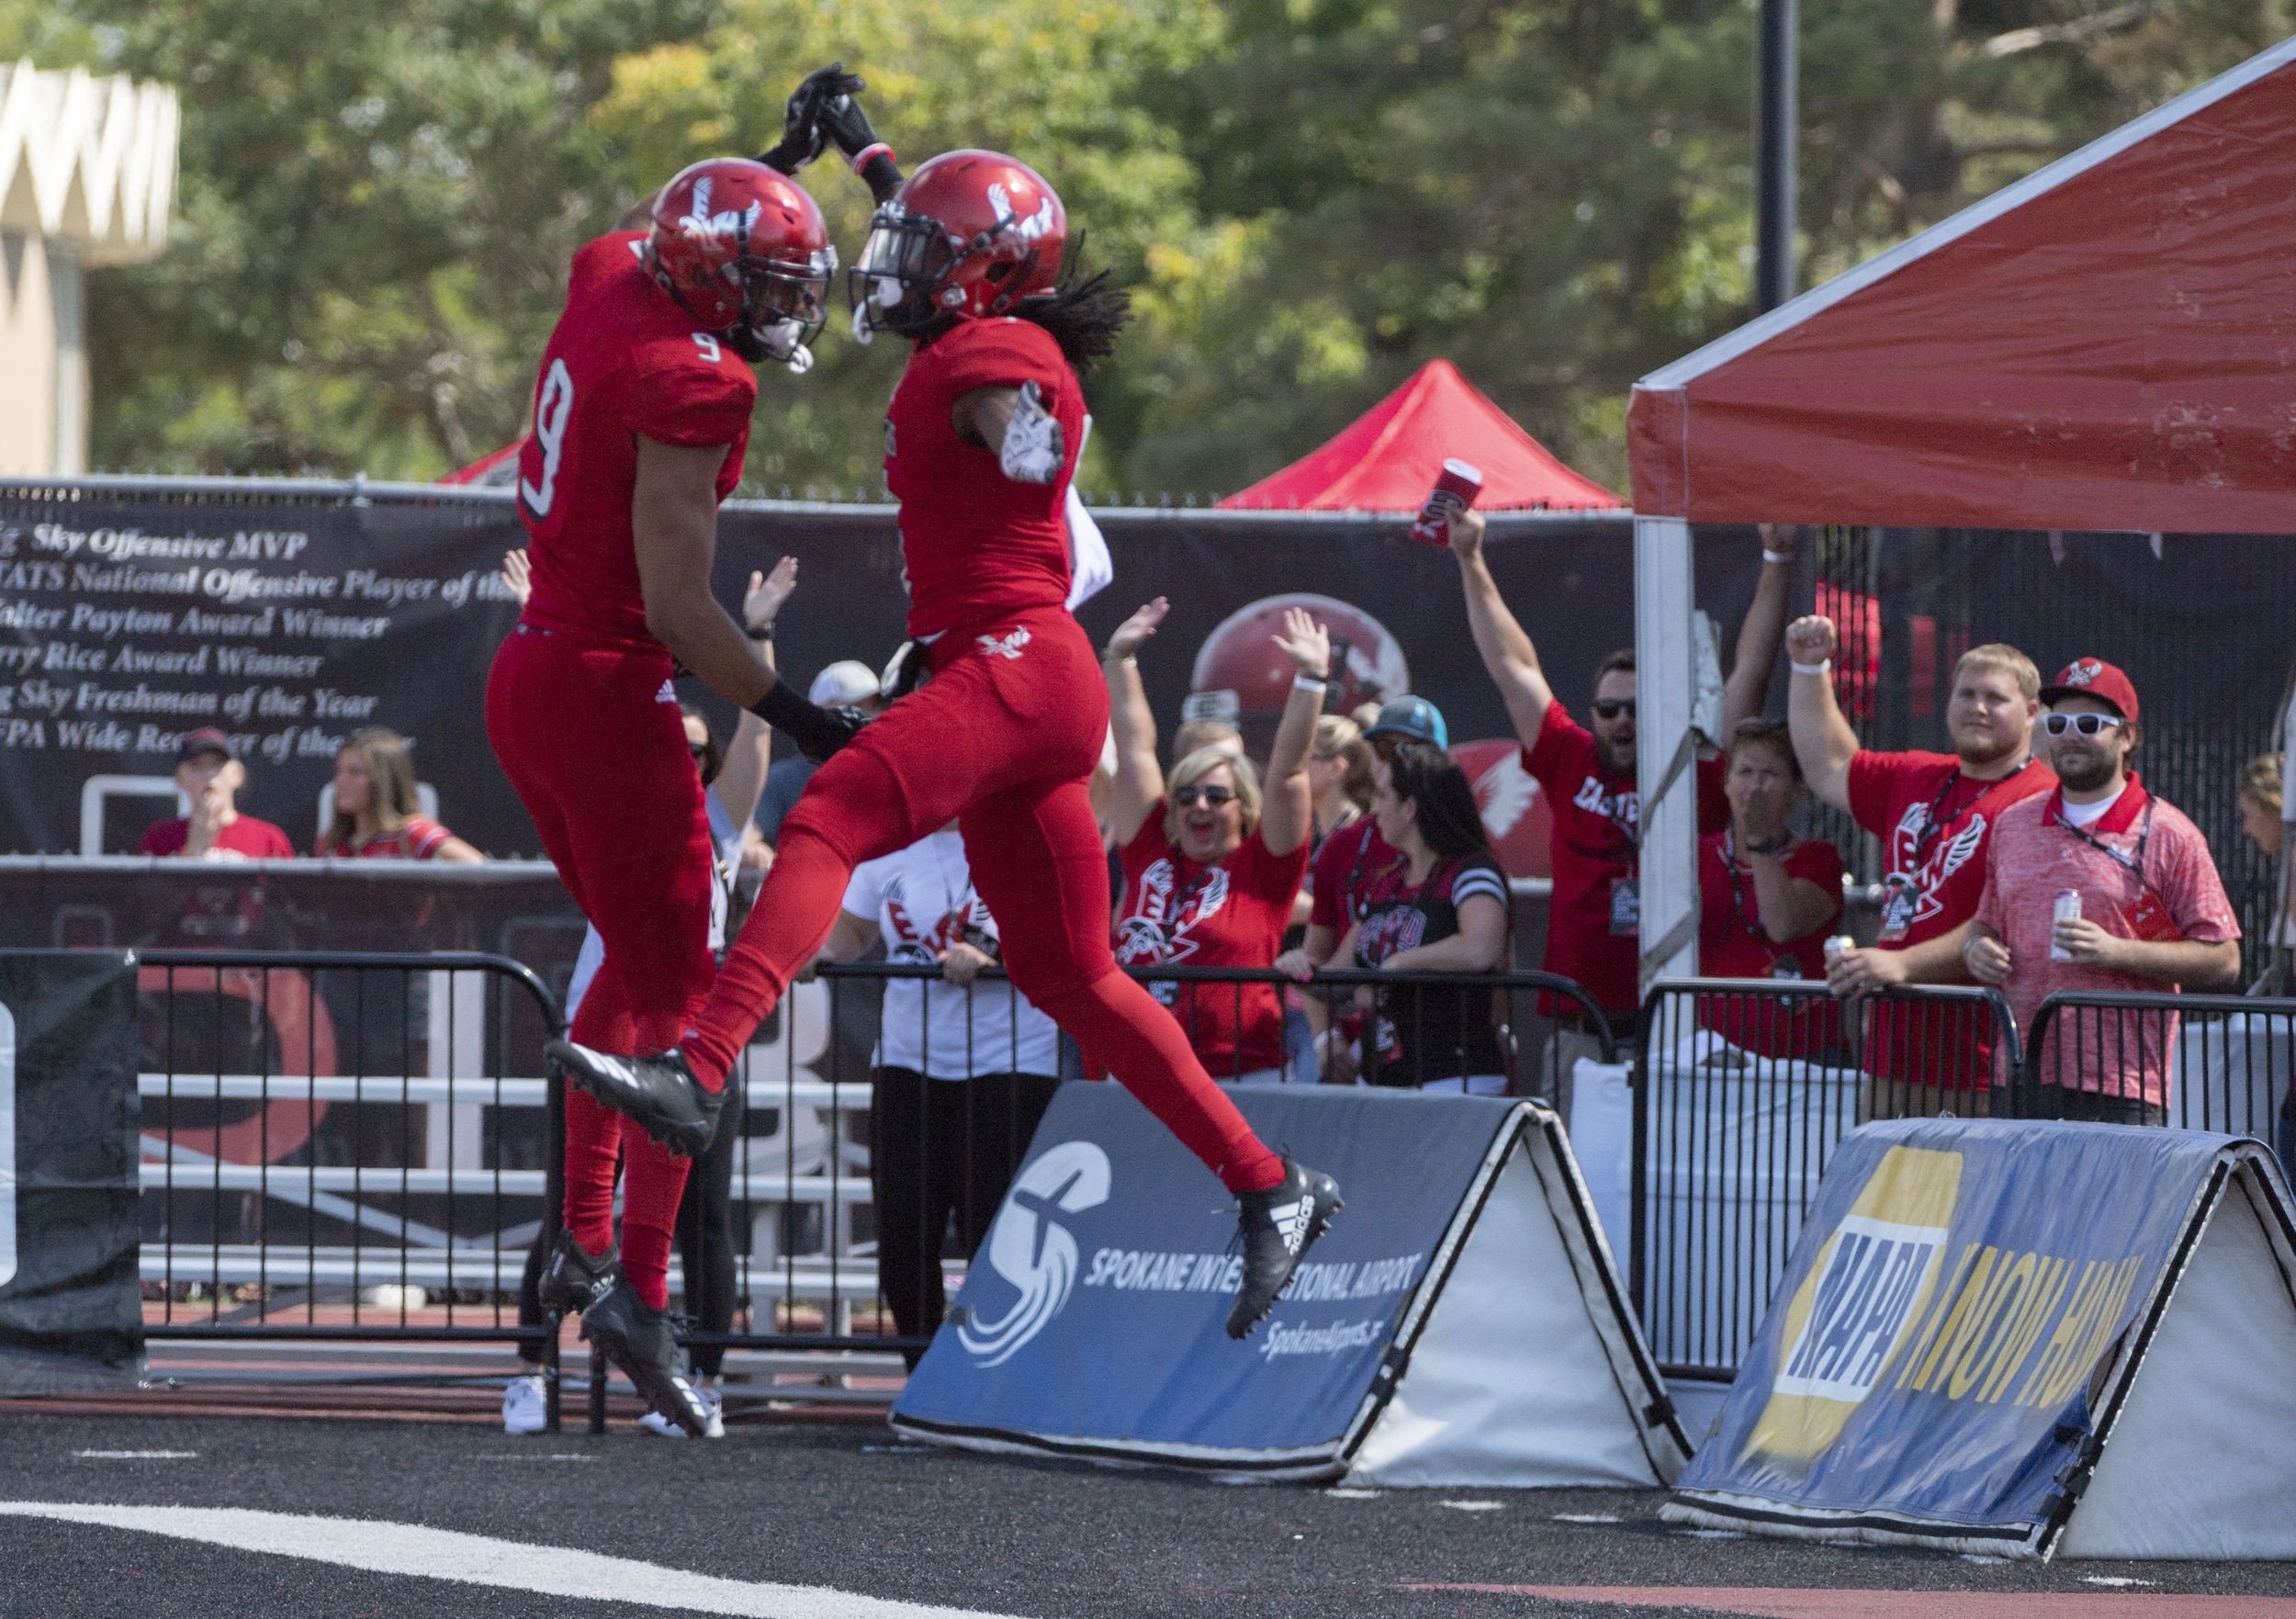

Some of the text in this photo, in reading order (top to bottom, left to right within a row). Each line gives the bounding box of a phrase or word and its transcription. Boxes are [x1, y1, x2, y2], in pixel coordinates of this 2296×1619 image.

[690, 332, 722, 363] 9
[521, 357, 574, 522] 9
[33, 522, 87, 558] Sky
[89, 527, 226, 561] Offensive
[228, 531, 309, 561] MVP
[70, 562, 200, 594] National
[202, 567, 338, 603] Offensive
[341, 569, 439, 609] Player
[441, 569, 478, 609] of
[0, 599, 391, 640] alter Payton Award Winner
[43, 641, 108, 672] Rice
[110, 645, 211, 675] Award
[217, 646, 325, 678] Winner
[18, 680, 73, 717] Sky
[75, 681, 220, 715] Freshman
[222, 685, 261, 725] of
[257, 686, 307, 717] the
[314, 689, 380, 720] Year
[57, 720, 132, 751] Wide
[261, 725, 298, 766] of
[297, 725, 345, 759] the
[1289, 1194, 1315, 1256] adidas
[1083, 1247, 1196, 1292] SPOKANE
[1348, 1252, 1423, 1299] AIRPORT
[1786, 1231, 1934, 1388] NAPA
